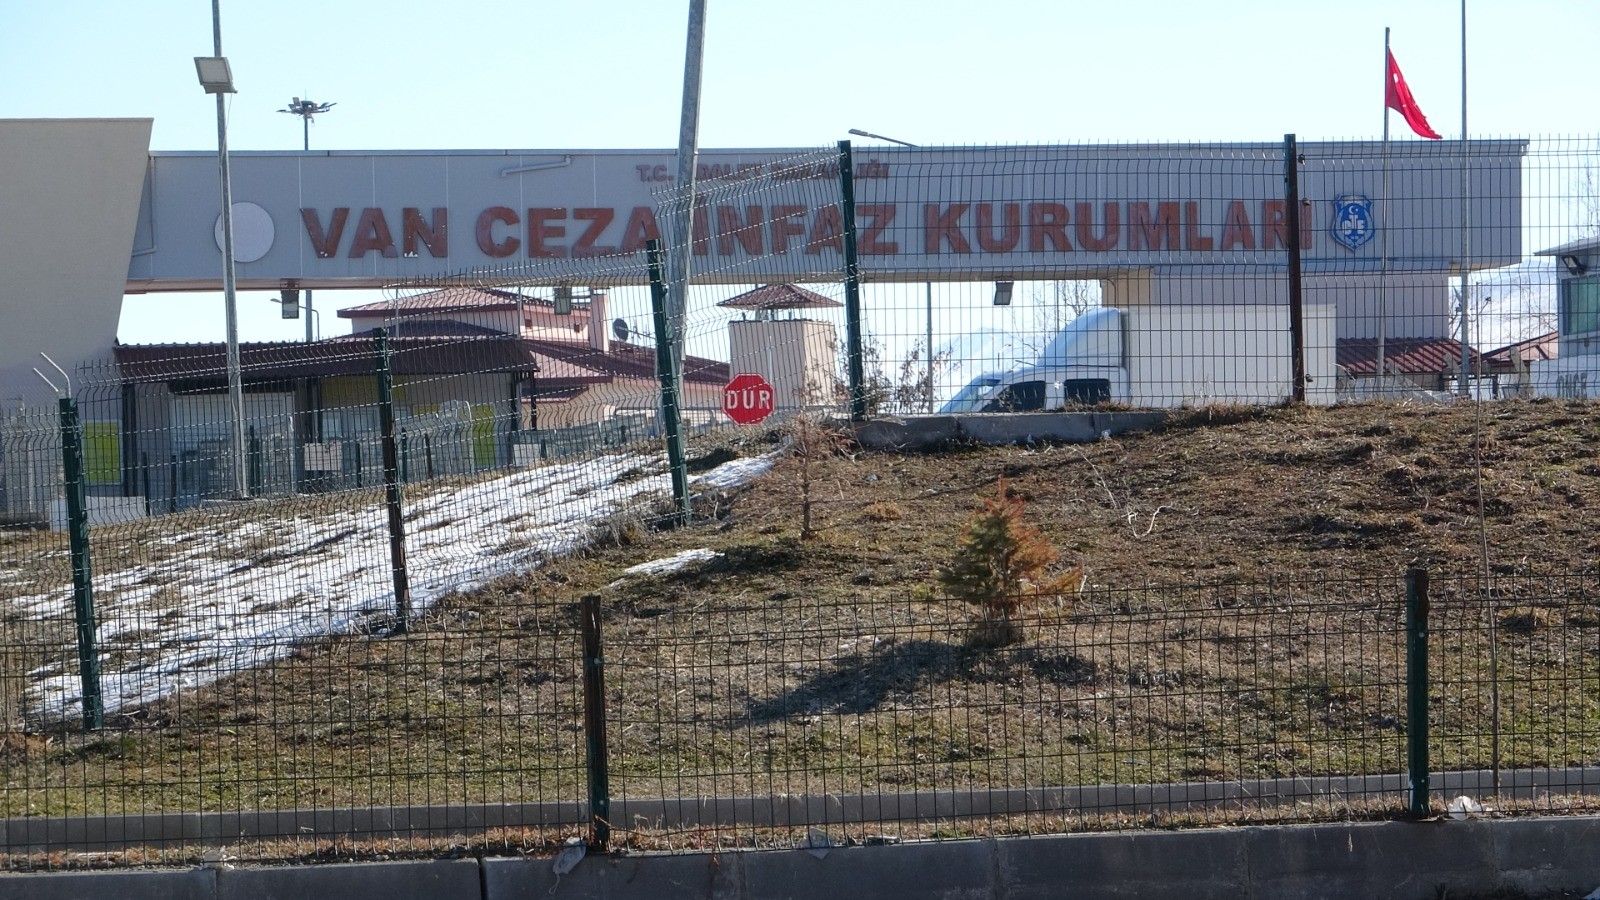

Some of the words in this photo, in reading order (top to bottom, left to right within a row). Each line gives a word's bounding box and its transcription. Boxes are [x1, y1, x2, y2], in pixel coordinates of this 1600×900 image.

[636, 164, 674, 182] T.C.
[299, 207, 449, 259] VAN
[475, 206, 665, 259] CEZA
[924, 199, 1312, 253] KURUMLARI
[726, 389, 770, 410] DUR
